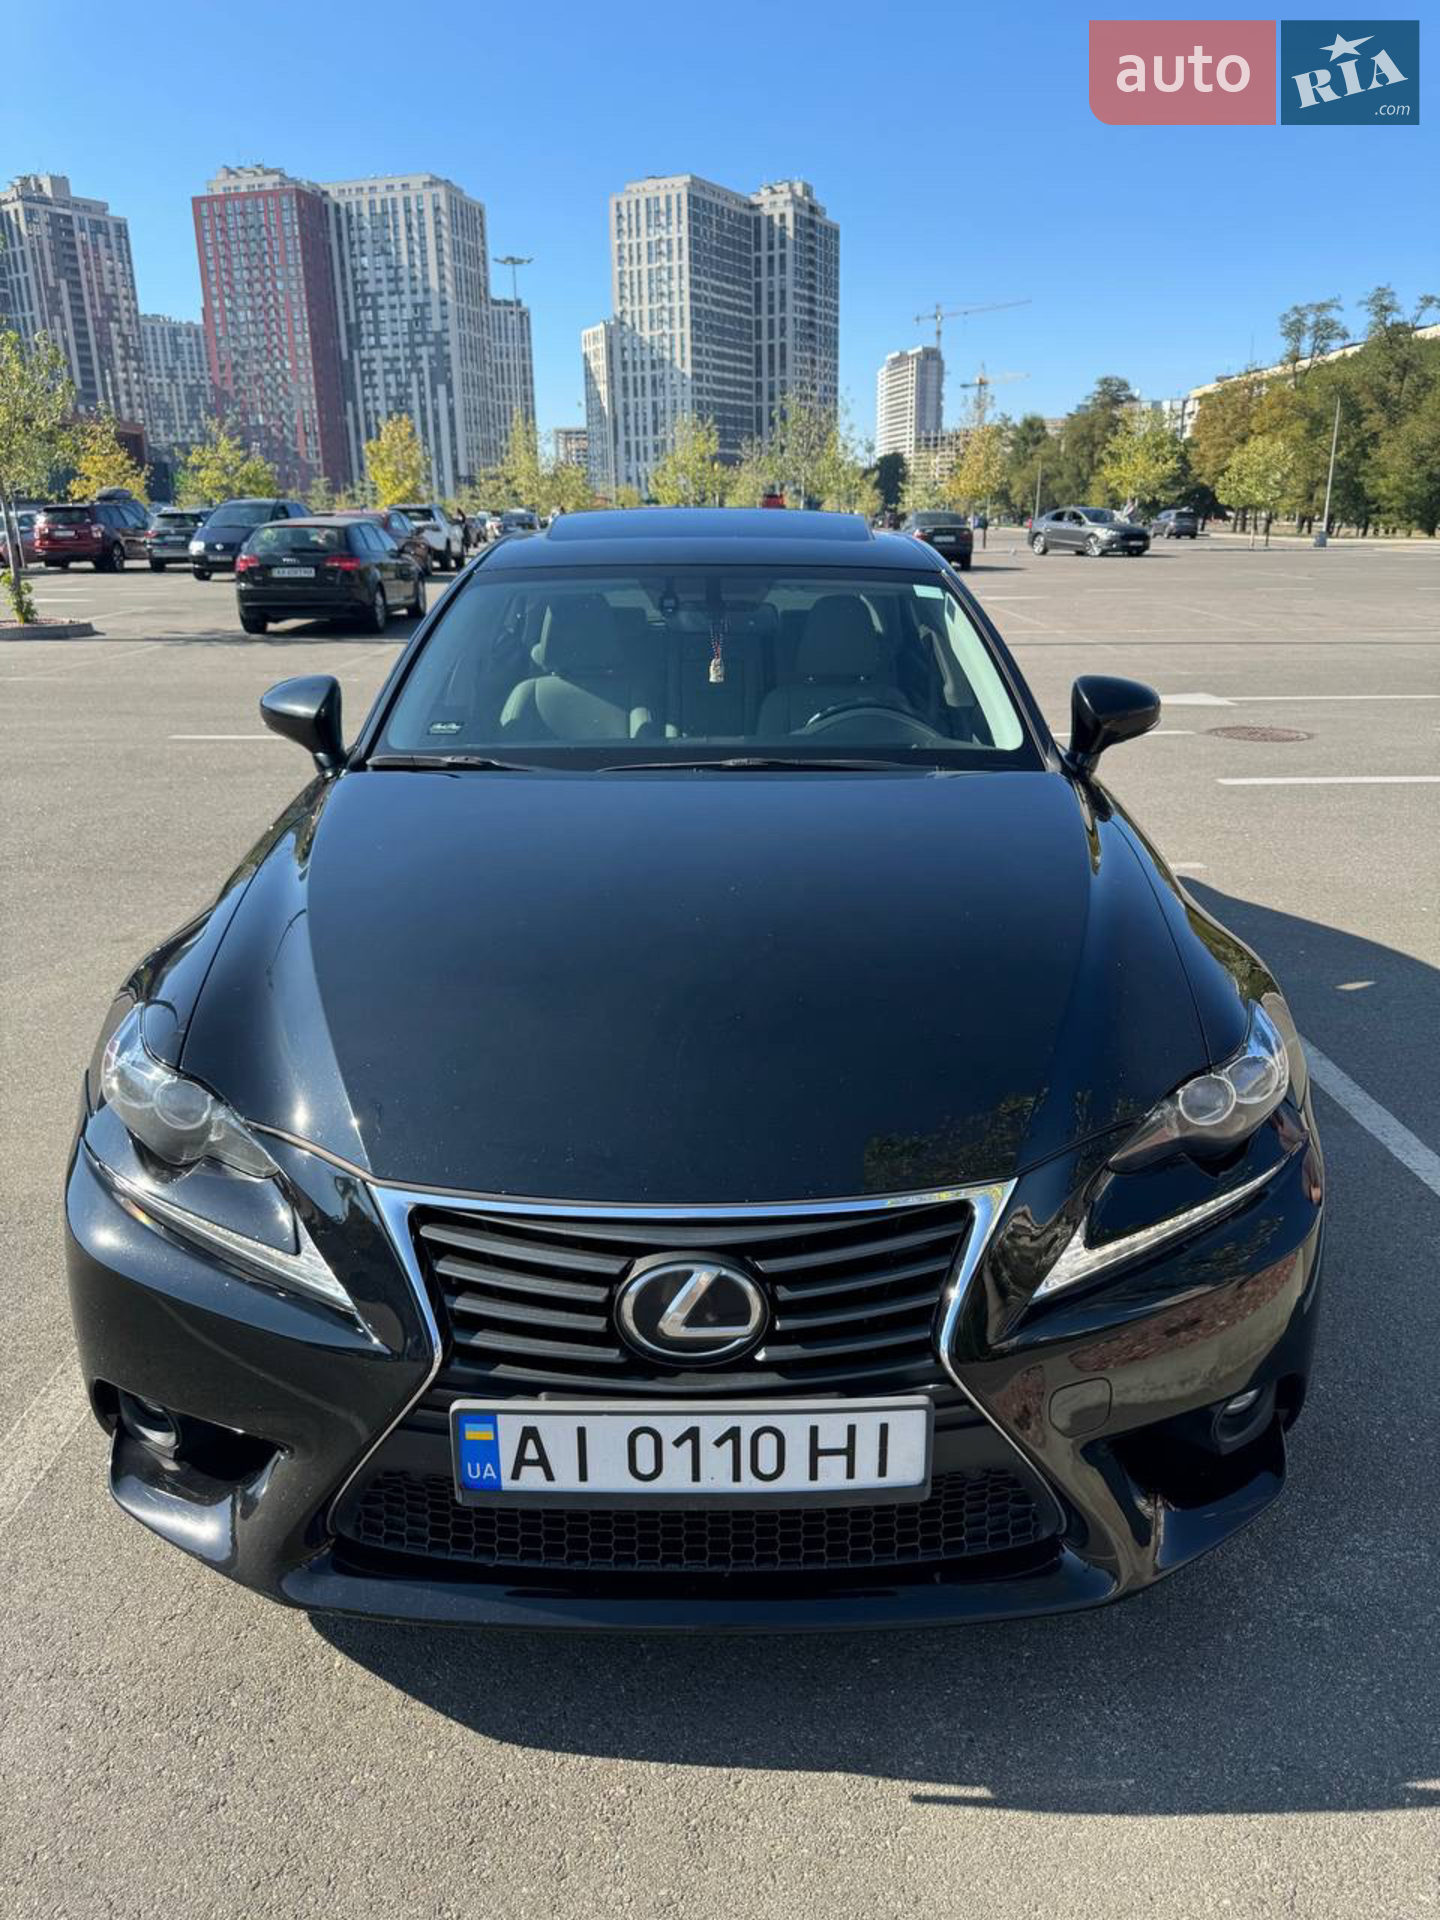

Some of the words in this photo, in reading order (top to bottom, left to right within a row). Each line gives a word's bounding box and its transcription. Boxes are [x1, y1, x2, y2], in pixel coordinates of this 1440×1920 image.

[467, 1462, 498, 1480] UA
[510, 1425, 588, 1482] AI
[626, 1425, 786, 1483] 0110
[808, 1422, 889, 1480] HI
